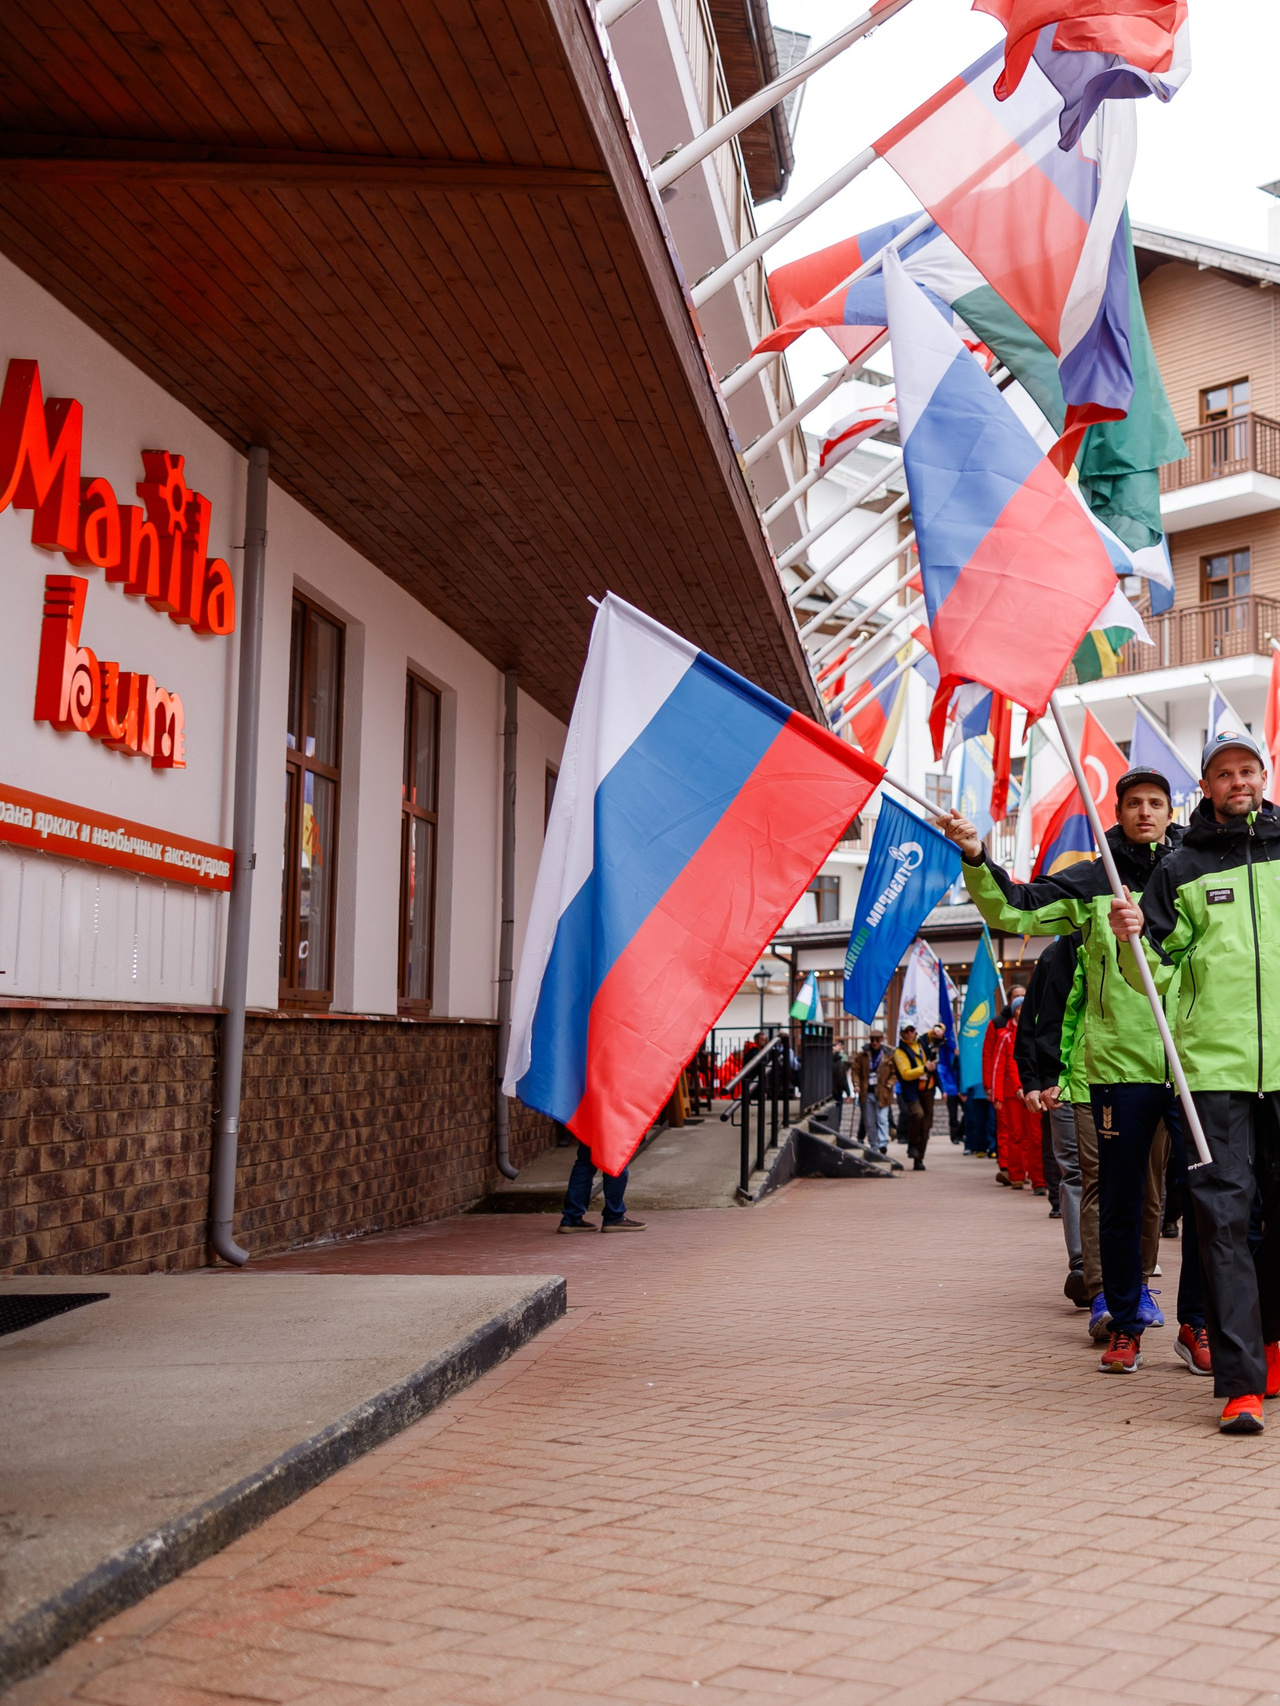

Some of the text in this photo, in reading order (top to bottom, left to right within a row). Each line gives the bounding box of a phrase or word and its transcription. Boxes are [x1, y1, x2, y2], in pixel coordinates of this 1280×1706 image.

[0, 358, 236, 636] Manila
[34, 574, 187, 769] bum
[33, 812, 80, 839] ярких
[80, 823, 91, 843] и
[92, 827, 163, 862] необычных
[164, 846, 230, 879] аксессуаров
